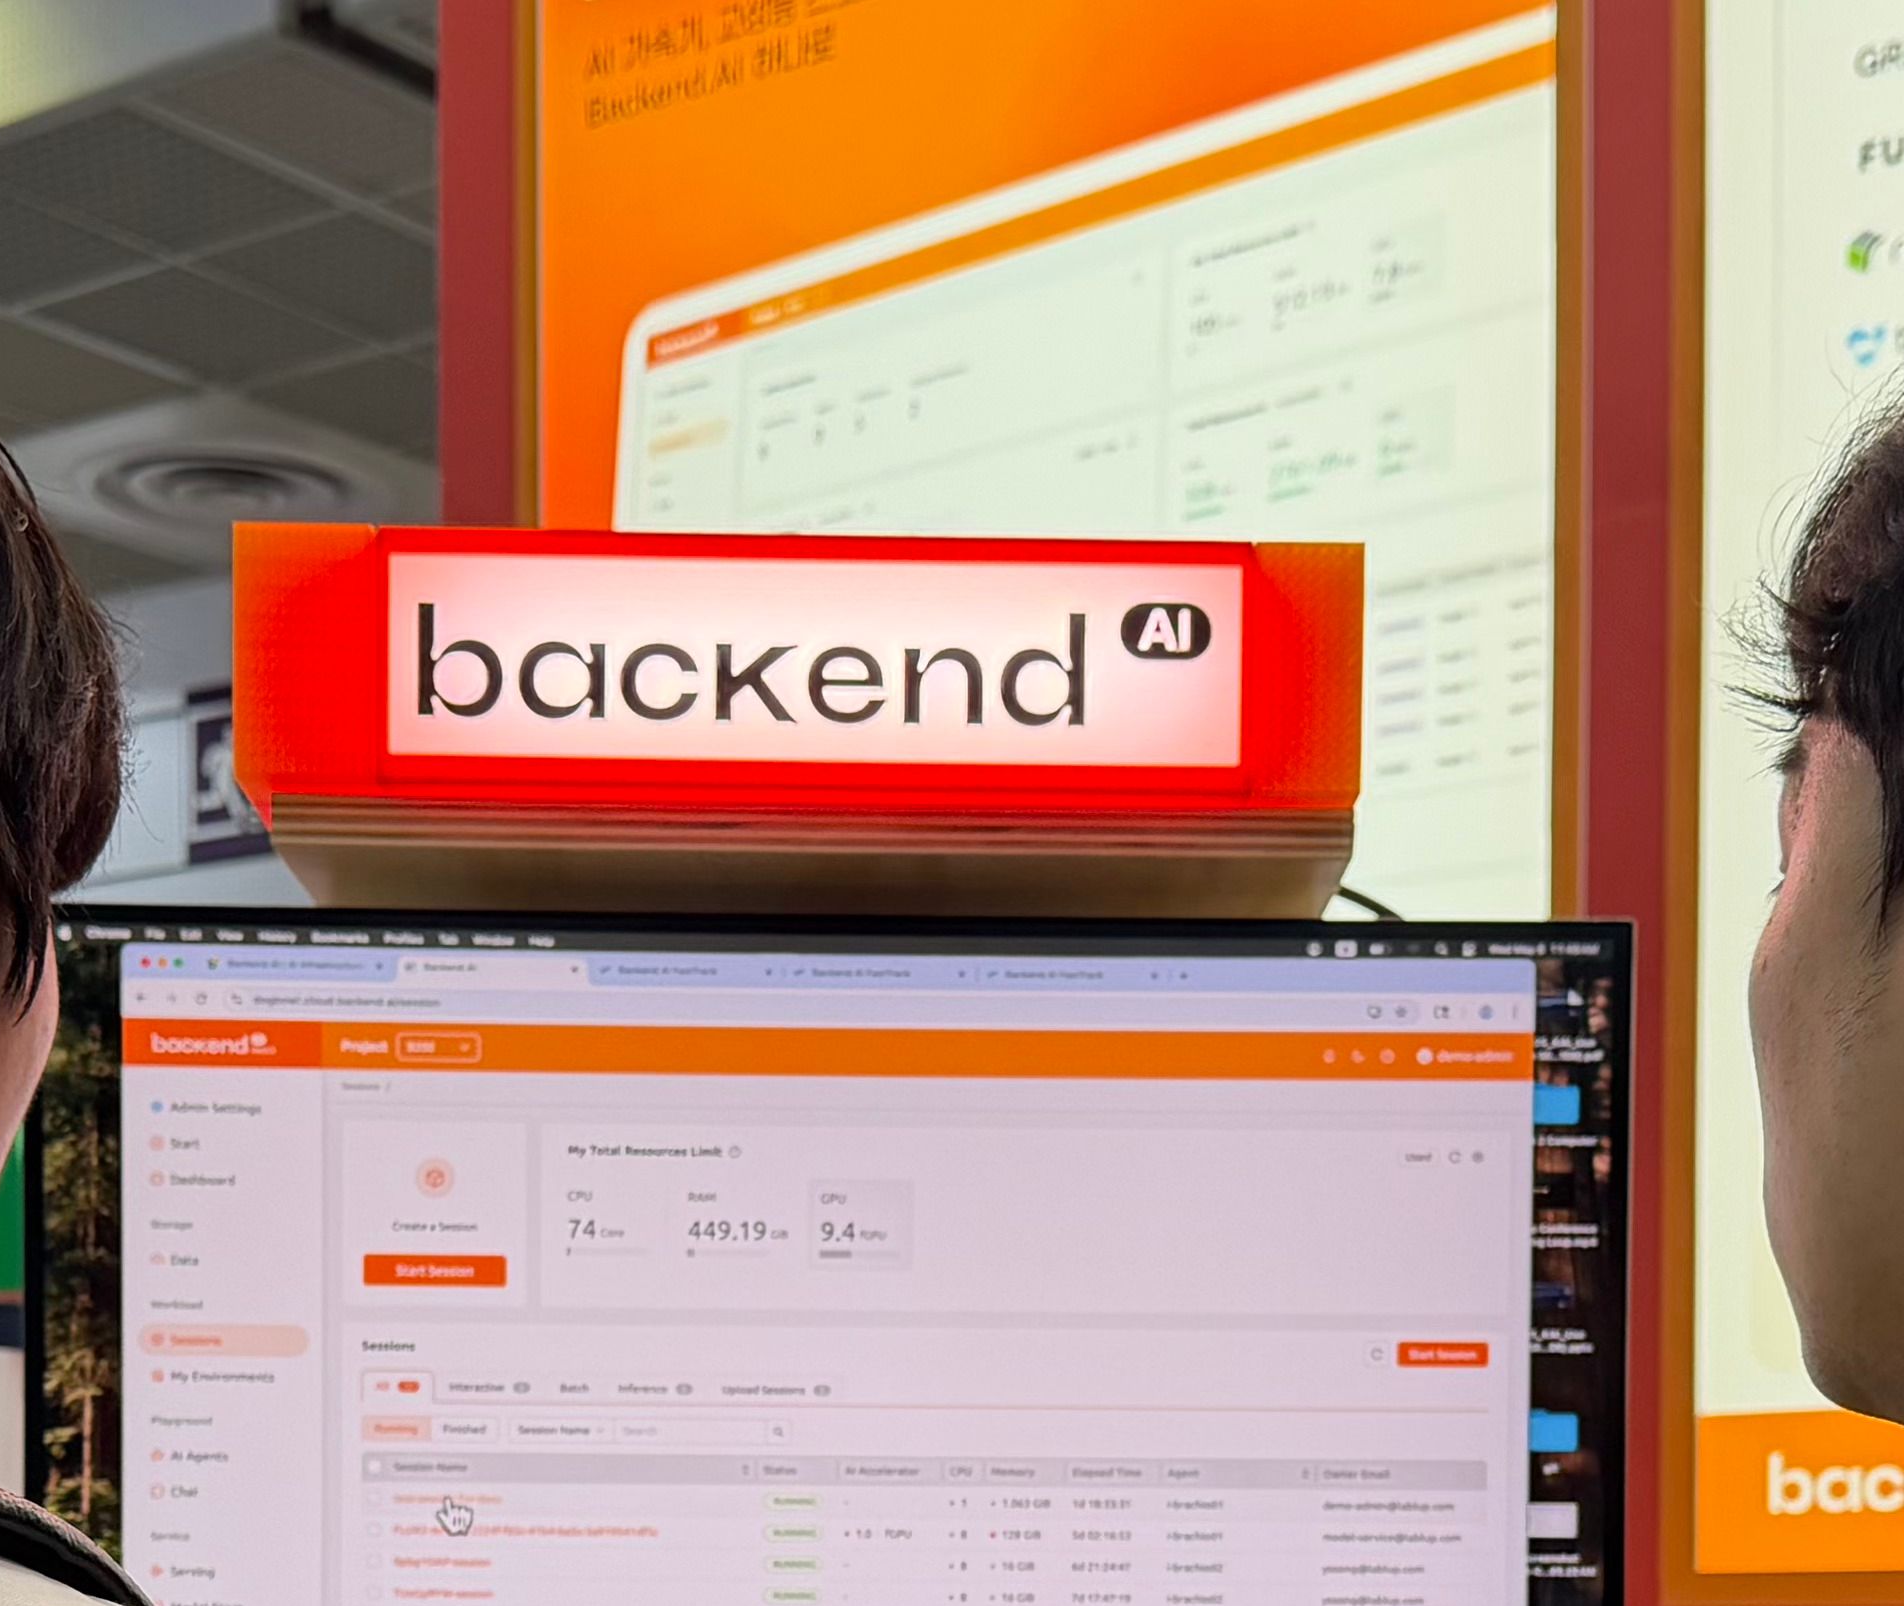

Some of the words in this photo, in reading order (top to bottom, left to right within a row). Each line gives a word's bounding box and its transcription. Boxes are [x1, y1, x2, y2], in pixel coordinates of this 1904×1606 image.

[416, 601, 1086, 728] backend
[1137, 607, 1194, 656] AI
[216, 929, 244, 942] View
[256, 930, 297, 945] History
[309, 931, 370, 944] Bookmarks
[382, 931, 425, 945] Profiles
[471, 934, 516, 947] Window
[527, 934, 556, 948] Help
[150, 1032, 250, 1055] backend
[340, 1038, 389, 1055] Project
[170, 1102, 208, 1114] Admin
[212, 1102, 262, 1116] Settings
[170, 1138, 200, 1150] Start
[567, 1145, 587, 1159] My
[590, 1145, 621, 1157] Total
[625, 1146, 687, 1158] Resources
[690, 1146, 723, 1158] Limit
[170, 1174, 236, 1187] Dashboard
[567, 1190, 594, 1203] CPU
[688, 1191, 718, 1203] RAM
[821, 1193, 848, 1206] GPU
[150, 1219, 194, 1232] Storage
[391, 1221, 427, 1233] Create
[438, 1221, 478, 1233] Session
[567, 1218, 597, 1241] 74
[687, 1220, 768, 1242] 449.19
[821, 1221, 856, 1244] 9.4
[170, 1255, 199, 1267] Data
[394, 1264, 425, 1278] Start
[428, 1264, 475, 1278] Session
[150, 1299, 204, 1311] Workload
[170, 1335, 223, 1348] Sessions
[361, 1340, 416, 1353] Sessions
[1408, 1348, 1434, 1361] Start
[1437, 1349, 1478, 1362] Session
[171, 1371, 189, 1385] My
[192, 1370, 275, 1385] Environments
[449, 1383, 505, 1394] Interactive
[559, 1382, 590, 1395] Batch
[617, 1383, 669, 1395] Inference
[722, 1384, 758, 1398] Upload
[761, 1385, 806, 1397] Sessions
[151, 1415, 213, 1428] Playground
[374, 1423, 418, 1438] Running
[442, 1423, 487, 1435] Finished
[518, 1424, 557, 1437] Session
[560, 1424, 591, 1437] Name
[171, 1451, 183, 1463] AI
[185, 1451, 228, 1465] Agents
[393, 1461, 434, 1474] Session
[437, 1461, 468, 1474] Name
[763, 1466, 797, 1477] Status
[858, 1466, 919, 1477] Accelerator
[950, 1467, 972, 1477] CPU
[991, 1467, 1035, 1479] Memory
[1072, 1467, 1110, 1480] Elapsed
[1113, 1467, 1142, 1478] Time
[1167, 1468, 1200, 1480] Agent
[1323, 1469, 1358, 1480] Owner
[1360, 1469, 1390, 1480] Email
[171, 1485, 198, 1498] Chat
[150, 1531, 191, 1543] Service
[170, 1566, 215, 1580] Serving
